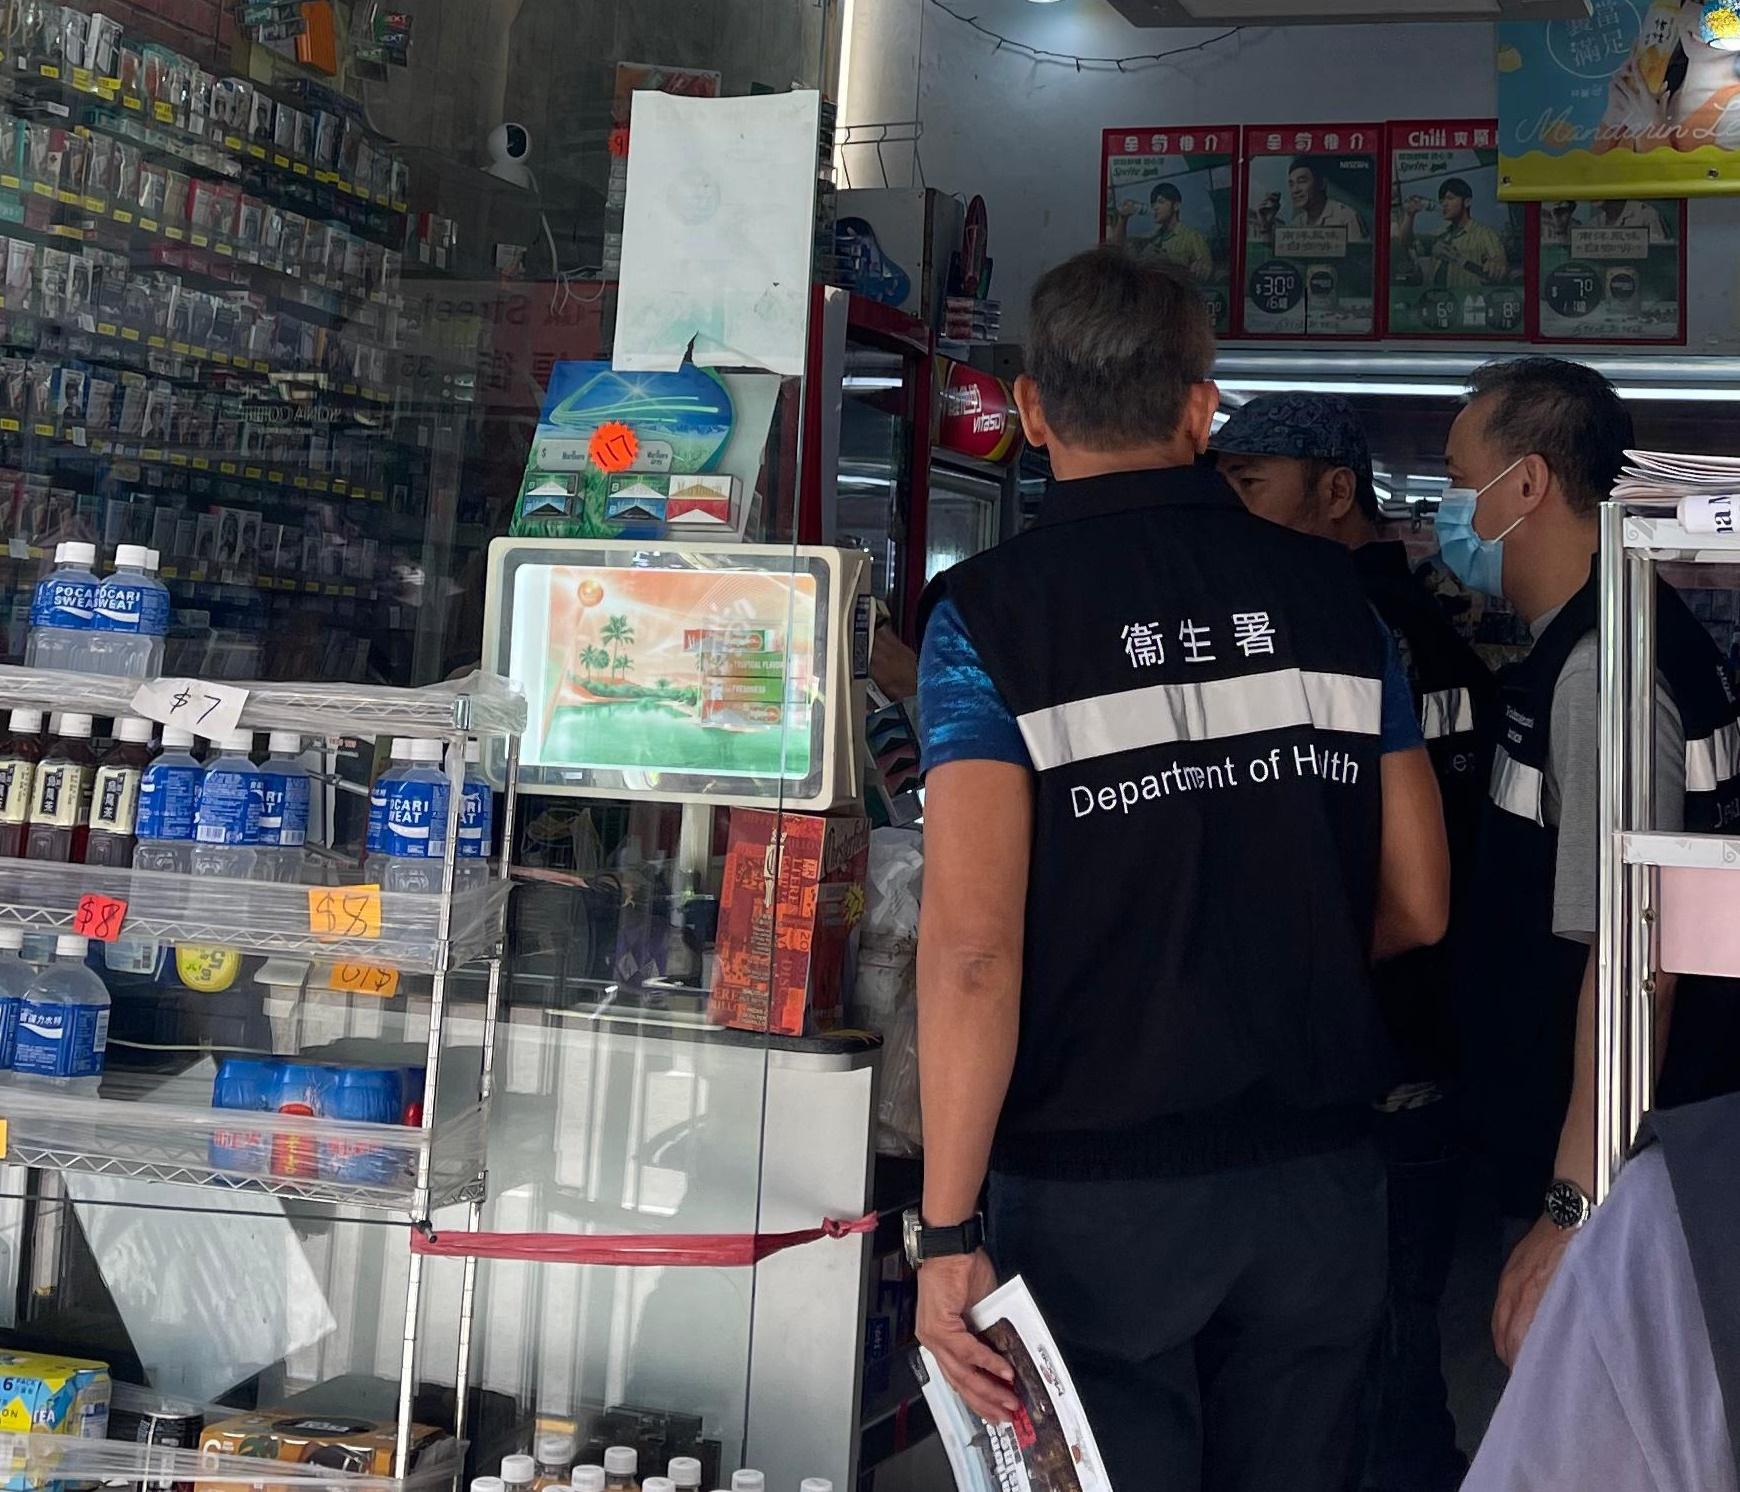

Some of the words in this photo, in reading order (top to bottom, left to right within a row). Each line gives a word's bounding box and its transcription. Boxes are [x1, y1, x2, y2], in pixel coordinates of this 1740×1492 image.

[1408, 128, 1447, 147] Chill
[55, 585, 93, 599] POCA
[54, 595, 93, 609] SWEA
[1250, 749, 1280, 783] of
[3, 1377, 14, 1391] 6
